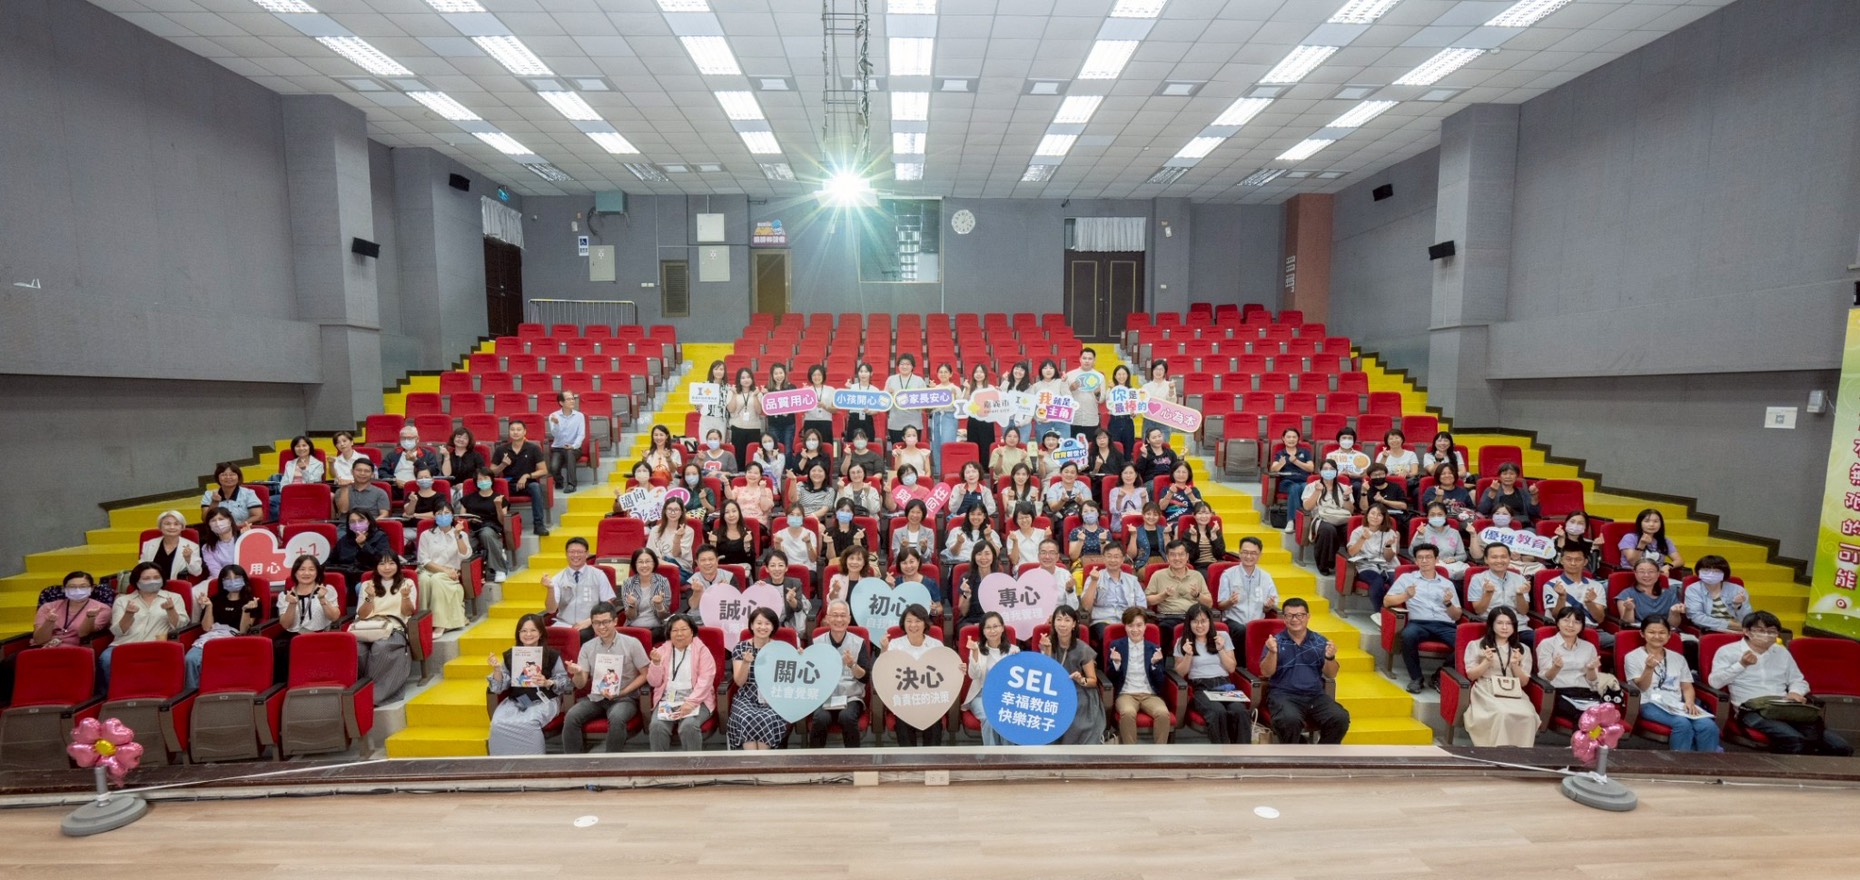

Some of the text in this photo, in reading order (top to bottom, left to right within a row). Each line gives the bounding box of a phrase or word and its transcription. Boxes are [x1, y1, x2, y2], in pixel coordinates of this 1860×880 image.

[765, 394, 814, 410] 品質用心
[837, 395, 877, 406] 小孩開心
[909, 393, 950, 404] 家長安心
[1112, 388, 1137, 401] 你是
[1115, 401, 1147, 413] 最棒的
[1160, 408, 1196, 427] 心為本
[925, 486, 949, 512] 同在
[1484, 529, 1547, 550] 優質教育
[295, 543, 320, 557] +1
[249, 562, 280, 575] 用心
[868, 593, 908, 617] 初心
[998, 585, 1041, 608] 專心
[1545, 593, 1555, 605] 2
[773, 659, 820, 685] 關心
[895, 665, 944, 691] 決心
[1008, 665, 1058, 697] SEL
[892, 691, 950, 707] 負責任的決策
[1001, 691, 1059, 715] 幸福教師
[998, 708, 1056, 733] 快樂孩子
